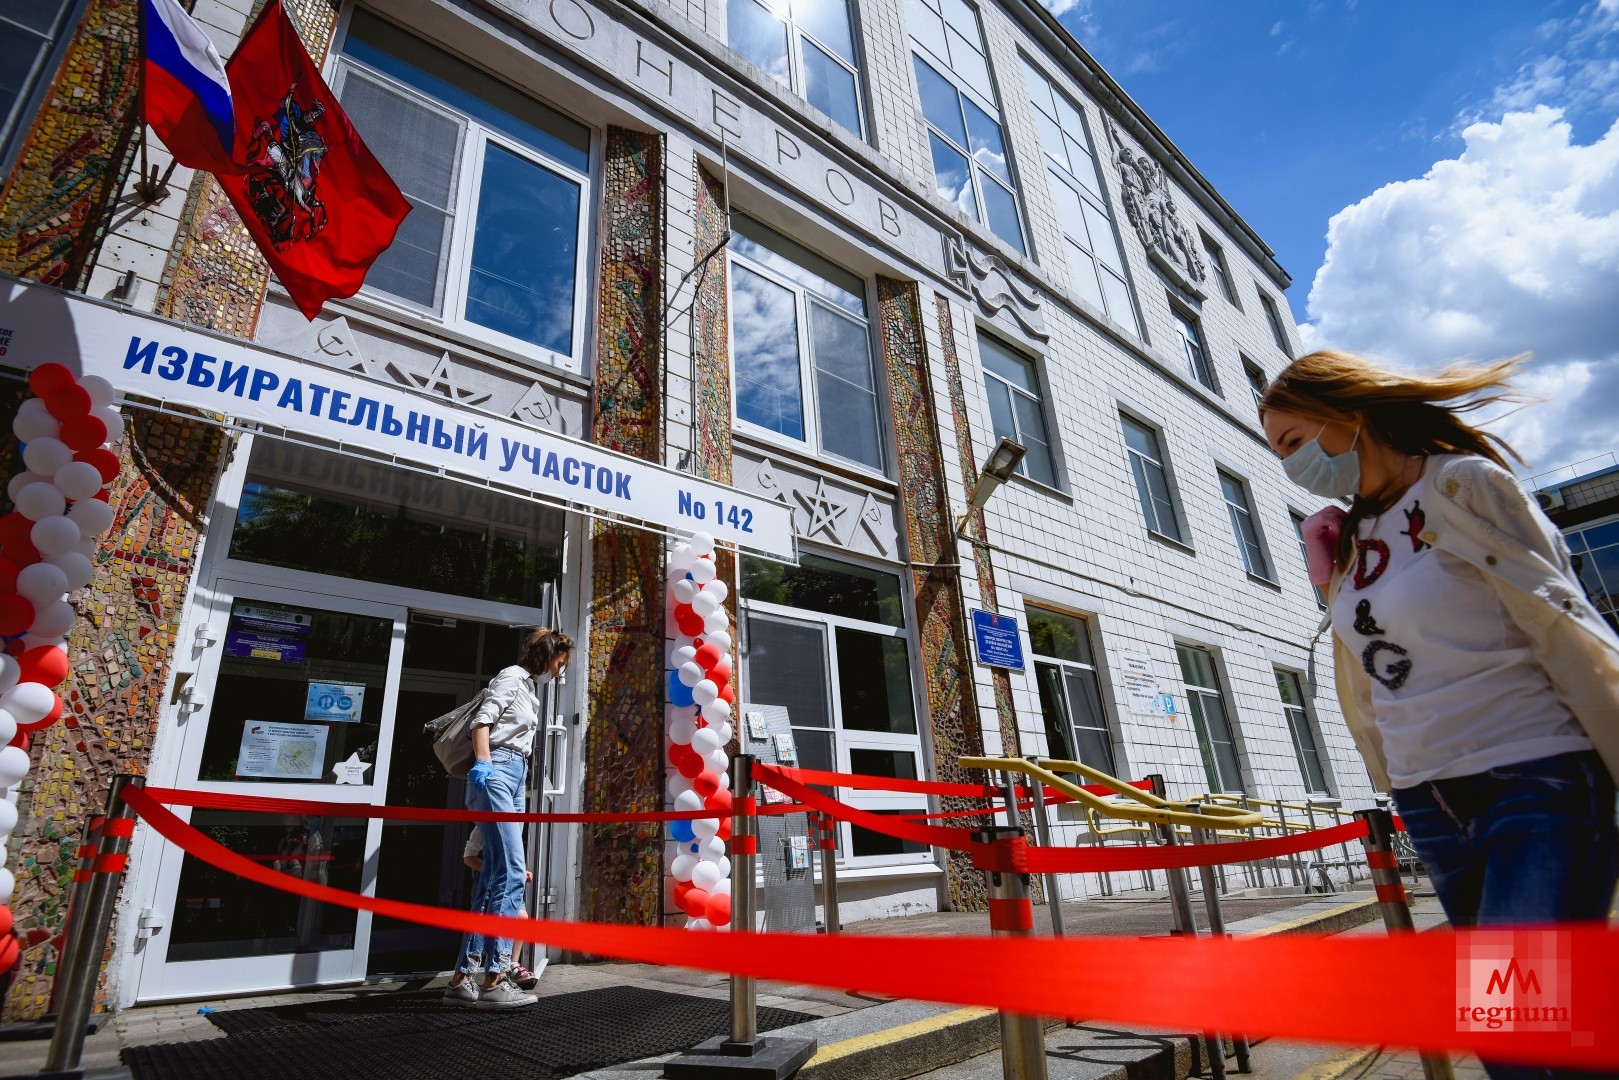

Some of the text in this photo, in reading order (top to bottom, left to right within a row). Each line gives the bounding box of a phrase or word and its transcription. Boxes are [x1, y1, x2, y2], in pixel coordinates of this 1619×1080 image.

[527, 0, 902, 238] ОНЕРОВ
[123, 336, 489, 461] ИЗБИРАТЕЛЬНЫЙ
[499, 437, 632, 501] УЧАСТОК
[714, 500, 754, 534] 142
